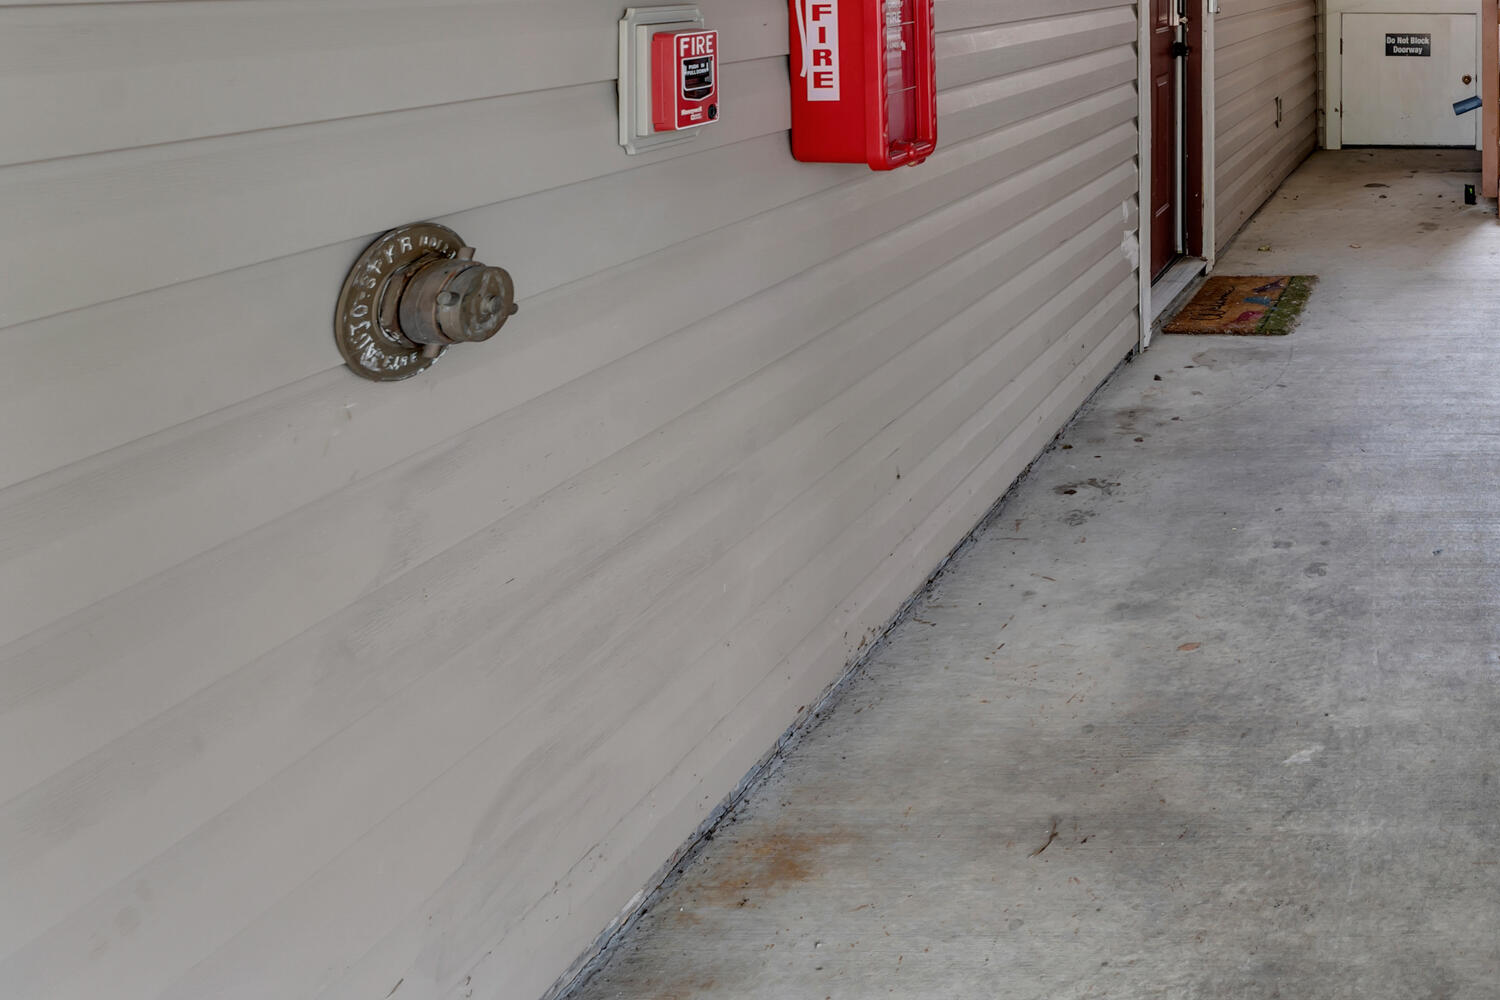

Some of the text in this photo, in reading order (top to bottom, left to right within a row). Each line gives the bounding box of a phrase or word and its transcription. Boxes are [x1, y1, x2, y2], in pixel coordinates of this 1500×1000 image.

[680, 35, 714, 57] FIRE
[812, 4, 833, 88] FIRE
[1397, 36, 1409, 44] Not
[1393, 46, 1422, 55] Doorway
